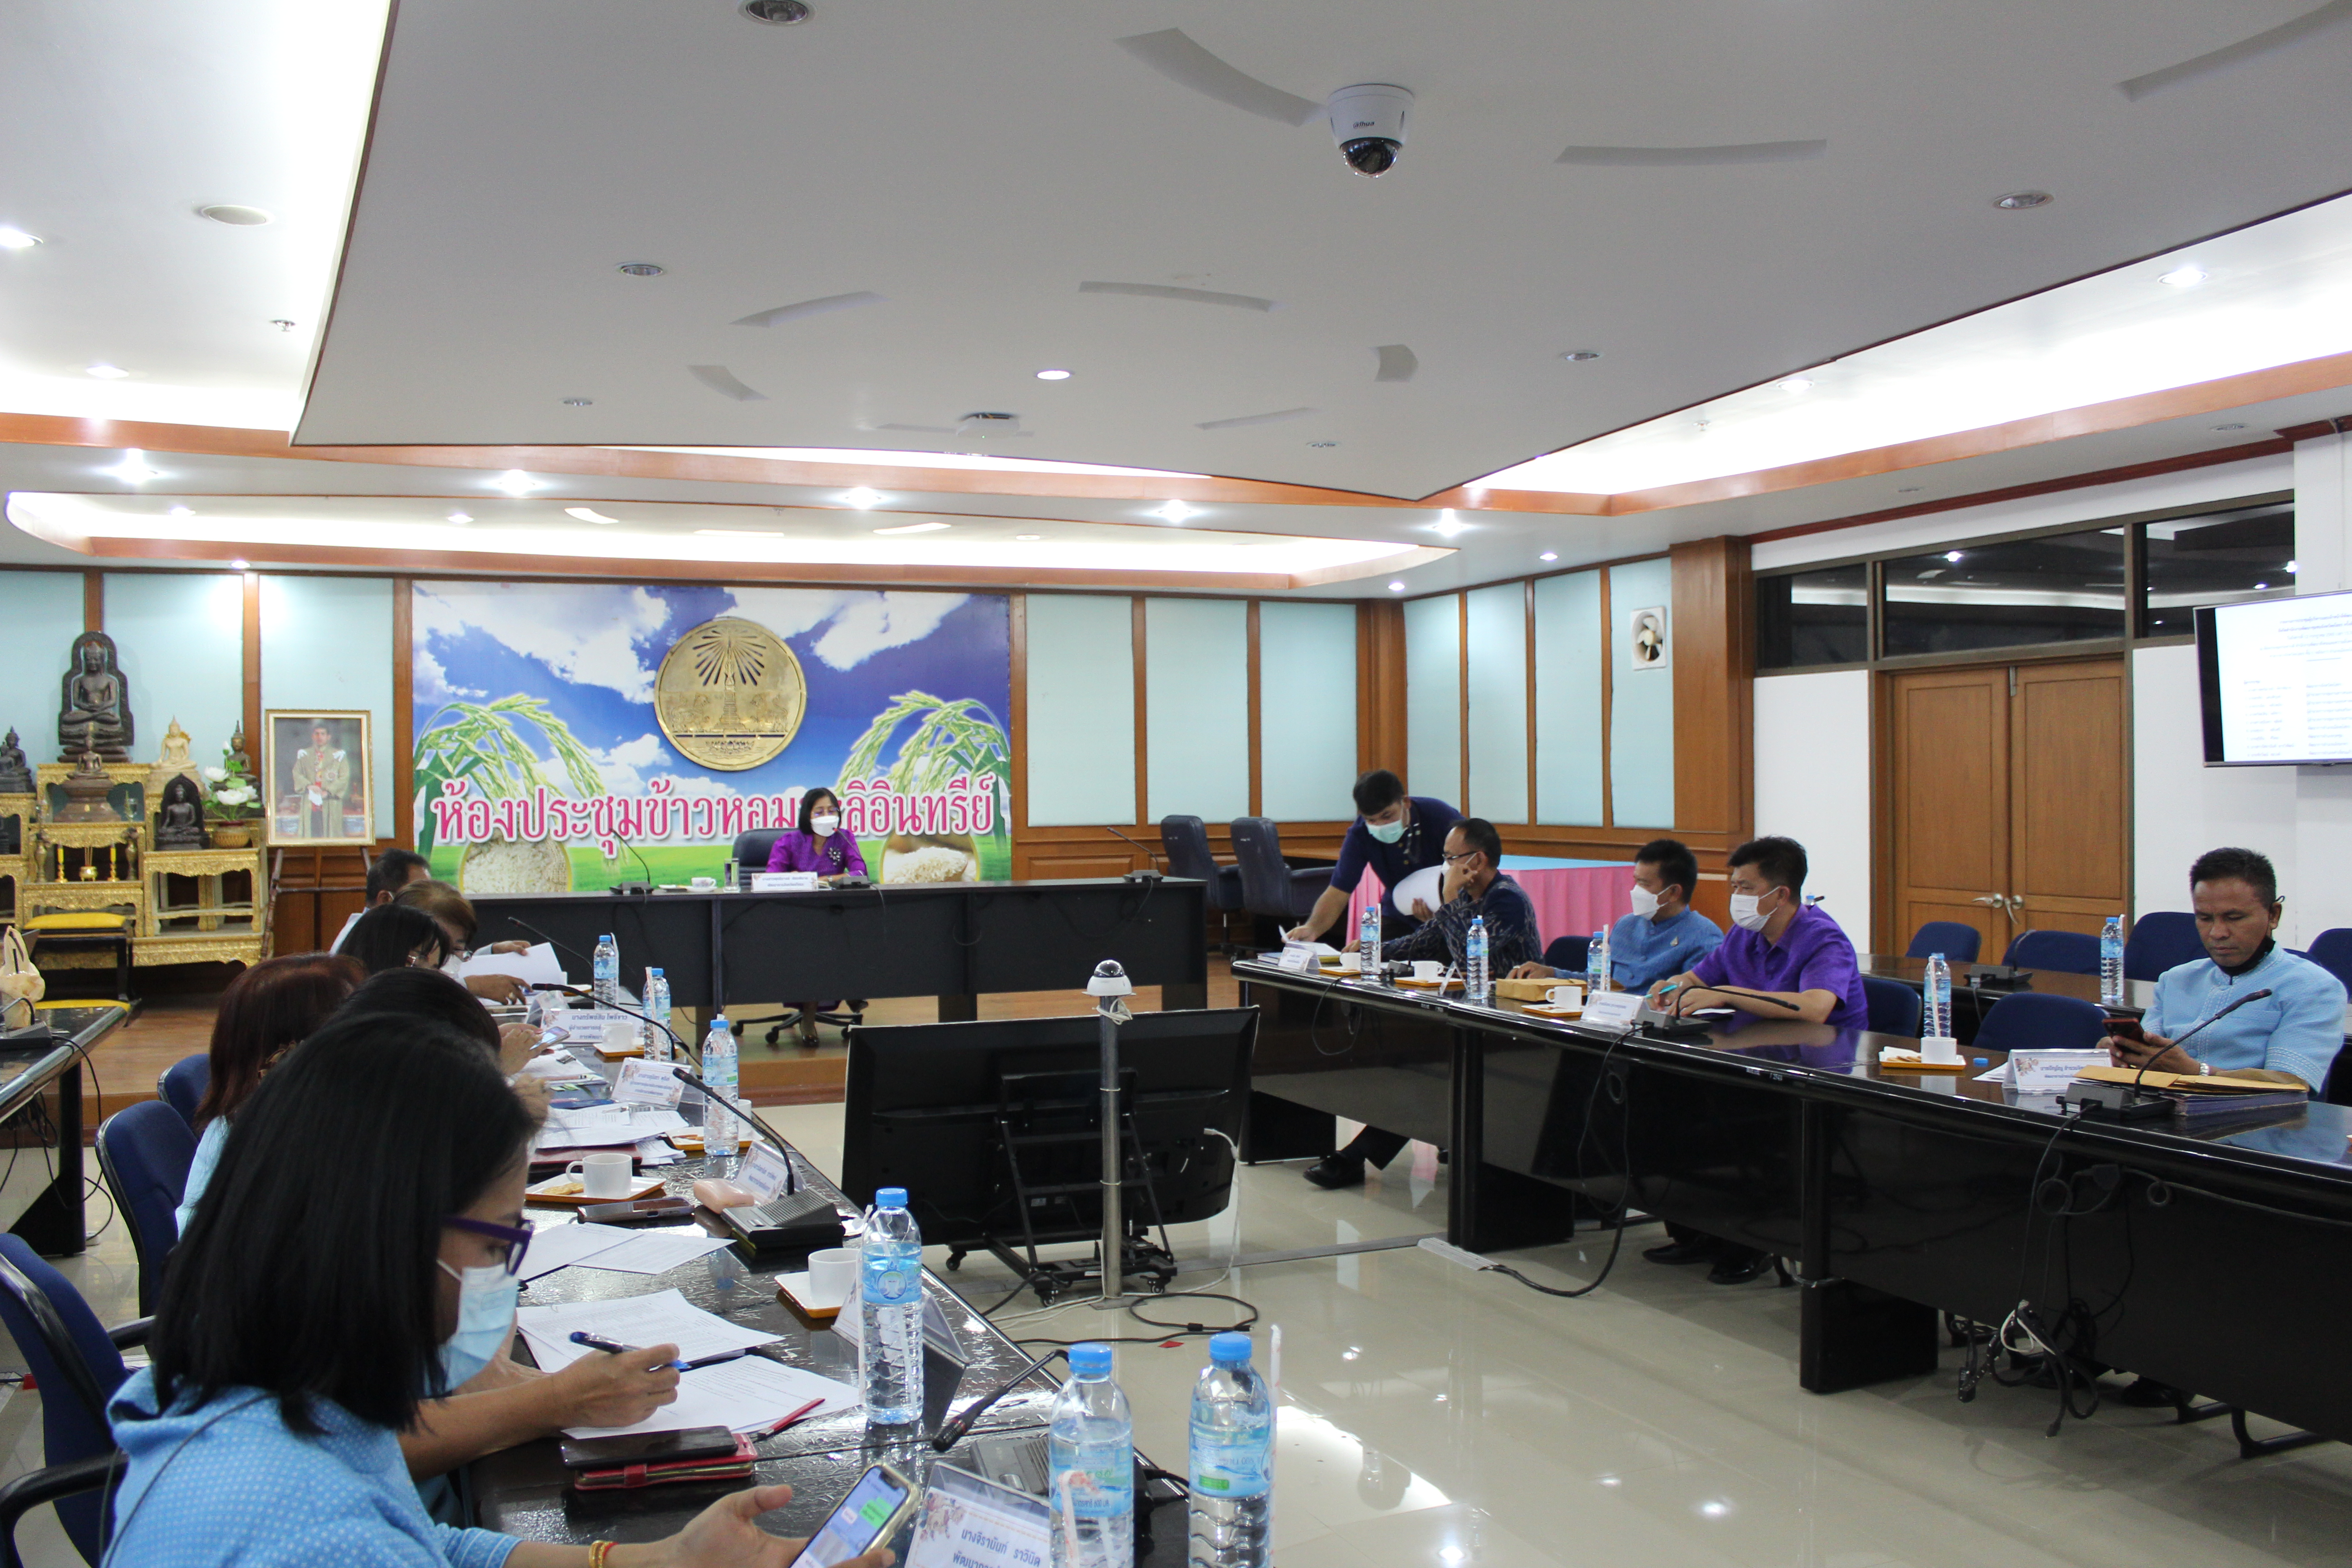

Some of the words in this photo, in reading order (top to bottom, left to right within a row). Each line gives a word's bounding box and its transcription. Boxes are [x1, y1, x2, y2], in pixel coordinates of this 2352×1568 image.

[433, 774, 995, 856] ห้องประชุมข้าวหอมลิอินทรีย์
